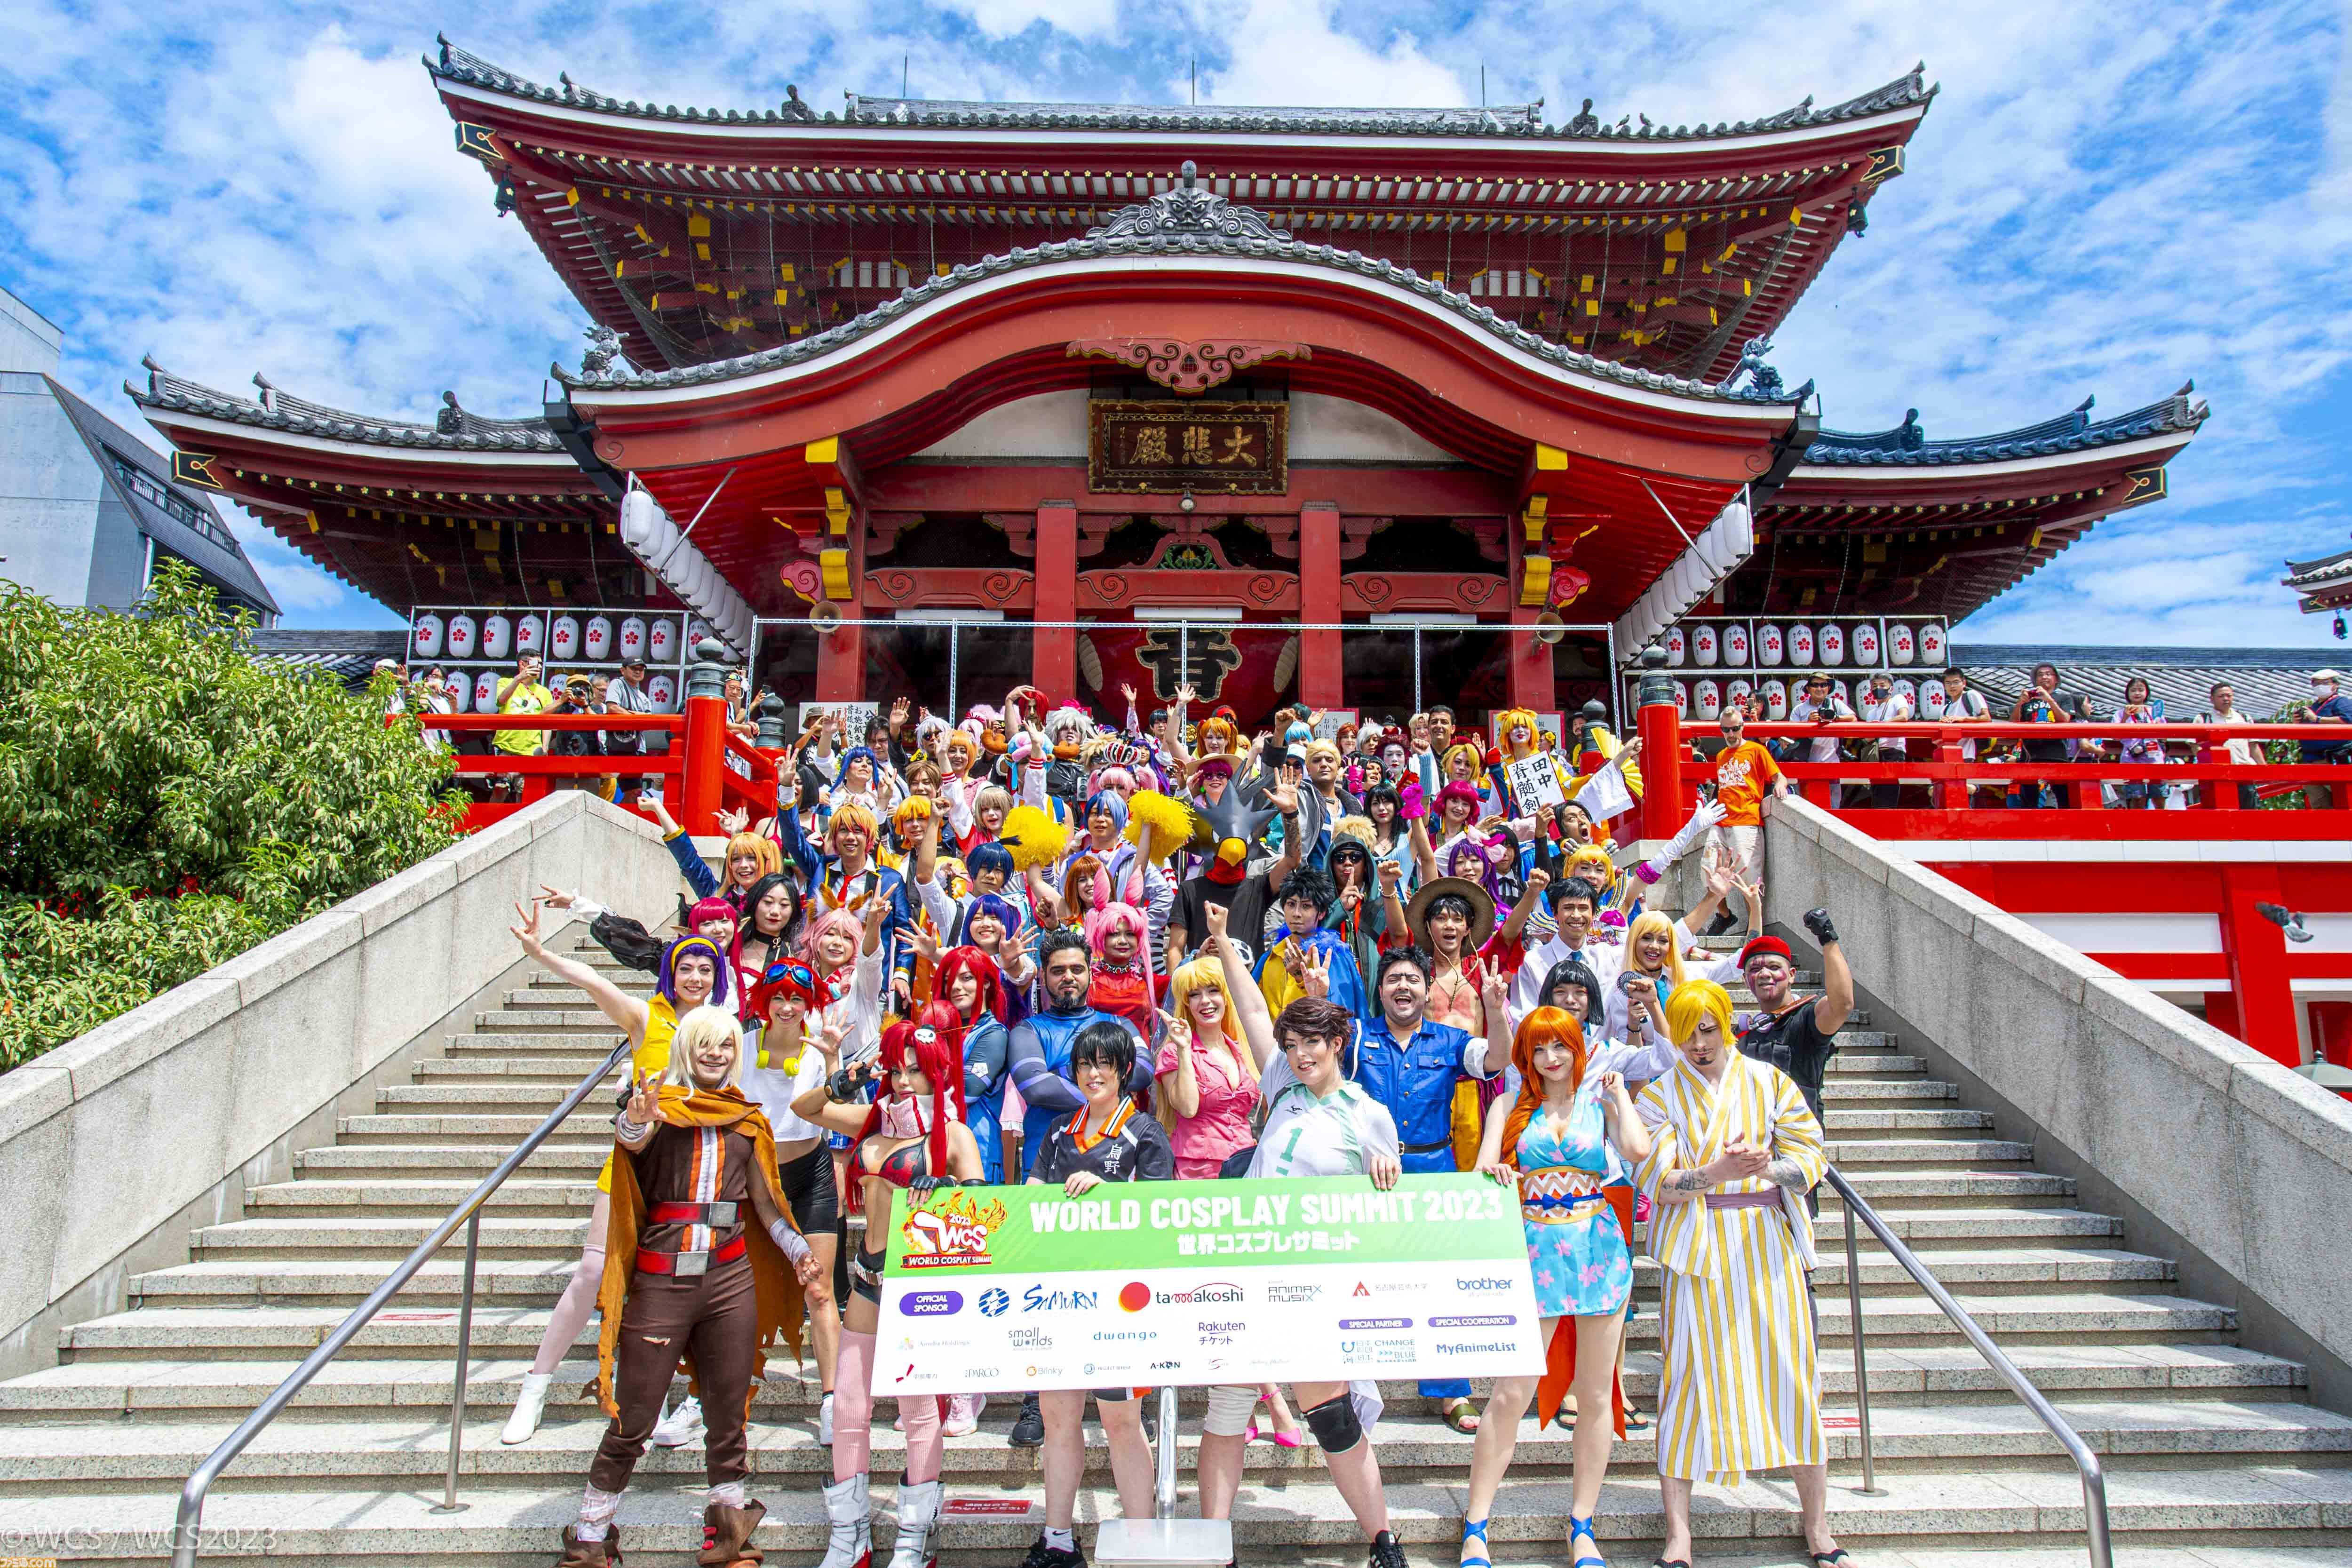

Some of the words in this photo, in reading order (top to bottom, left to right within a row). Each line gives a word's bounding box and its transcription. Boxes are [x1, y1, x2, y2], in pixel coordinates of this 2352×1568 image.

[1532, 757, 1551, 788] 田中
[1512, 763, 1541, 814] 脊髄剣
[1279, 1127, 1303, 1163] 1
[1030, 1200, 1140, 1233] WORLD
[1150, 1194, 1290, 1229] COSPLAY
[1301, 1191, 1416, 1224] SUMMIT
[1425, 1189, 1503, 1221] 2023
[948, 1213, 971, 1226] 2023
[1177, 1230, 1360, 1256] 世界コスプレサミット
[909, 1257, 939, 1266] WORLD
[941, 1256, 971, 1265] COSPLAY
[972, 1255, 992, 1264] SUMMIT
[1457, 1277, 1512, 1291] brother
[914, 1304, 948, 1312] SPONSOR
[1199, 1321, 1246, 1333] Rakuten
[1462, 1317, 1510, 1325] COOPERATION
[1009, 1327, 1039, 1338] small
[1093, 1330, 1157, 1341] dwango
[1199, 1336, 1233, 1345] チケット
[1437, 1342, 1517, 1355] MyAnimeList
[969, 1368, 999, 1377] PARCO
[1038, 1367, 1063, 1376] Blinky
